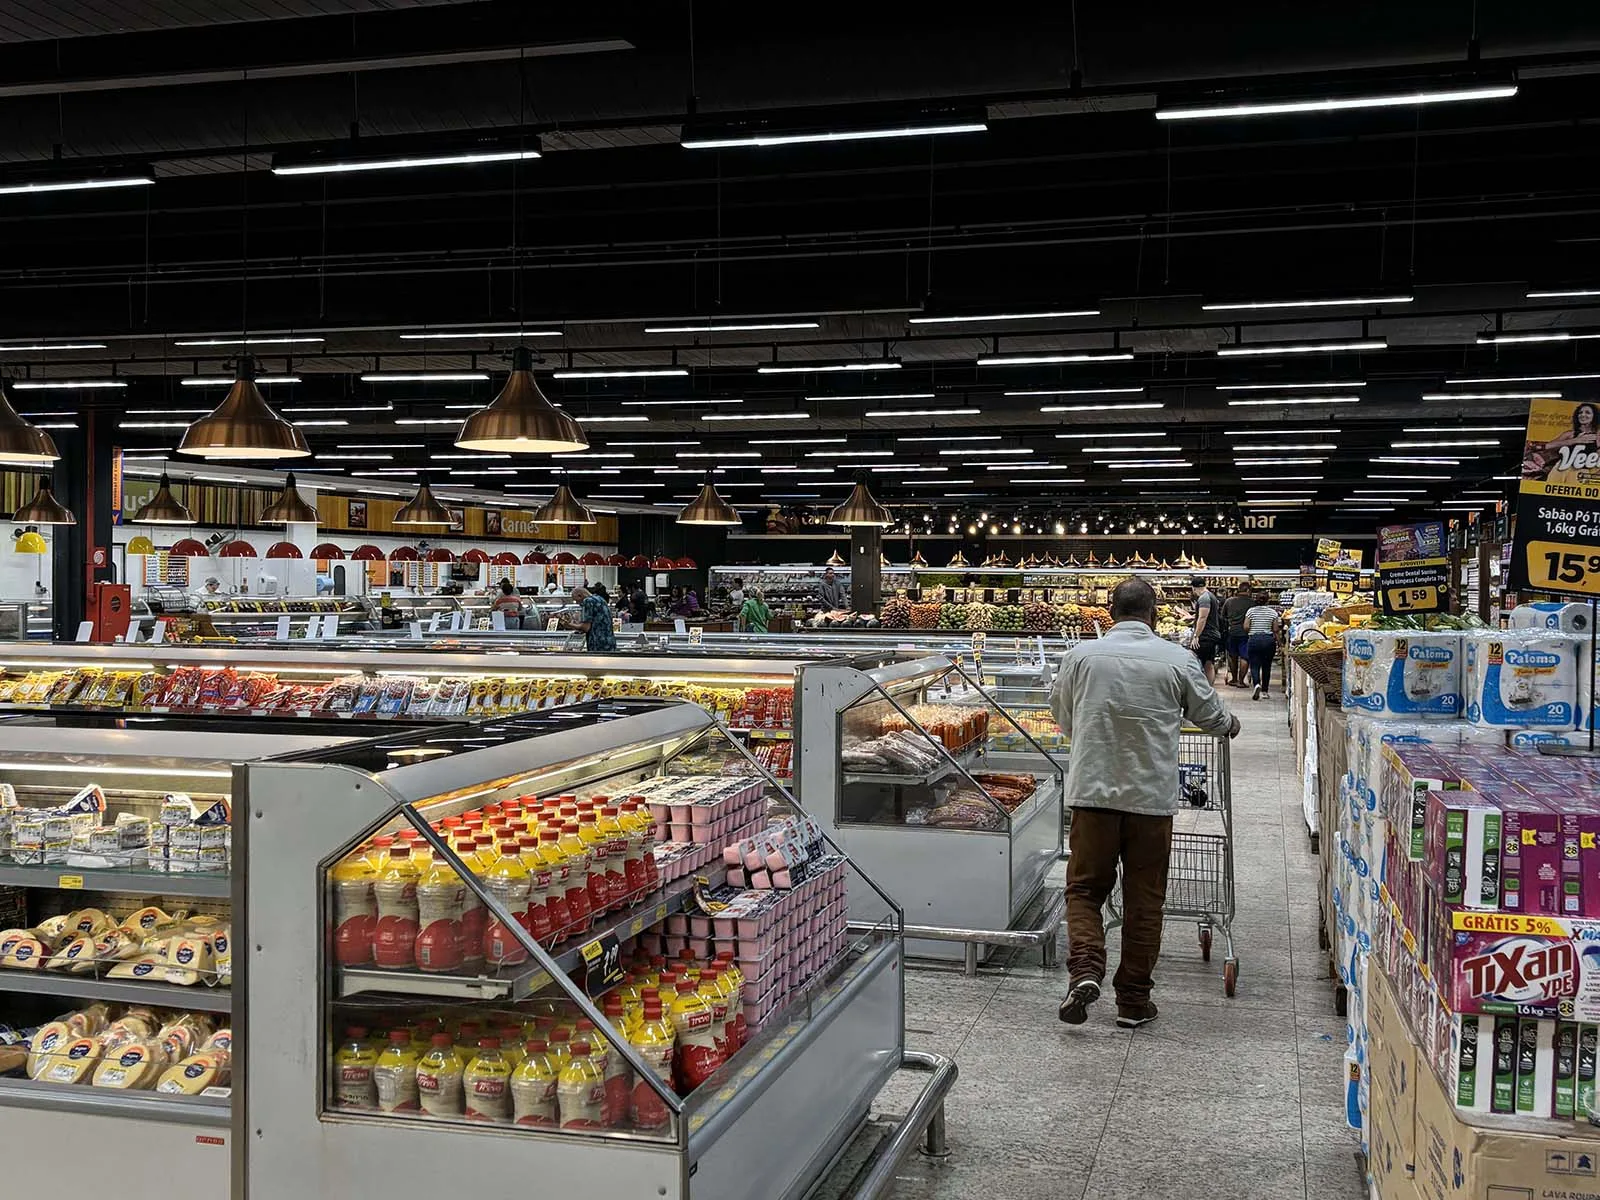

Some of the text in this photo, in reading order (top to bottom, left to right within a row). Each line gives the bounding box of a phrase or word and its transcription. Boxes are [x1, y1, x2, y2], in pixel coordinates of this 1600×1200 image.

[1559, 444, 1600, 470] Vee
[1545, 485, 1599, 497] OFERTA DO
[1538, 507, 1573, 520] Sabão
[1575, 510, 1591, 523] Pó
[501, 517, 540, 533] Carnes
[1545, 521, 1576, 537] 1,6kg
[1397, 639, 1406, 650] 12
[1489, 642, 1501, 655] 12
[1413, 647, 1451, 660] Paloma
[1508, 651, 1556, 664] Paloma
[1441, 695, 1455, 705] 20
[1548, 704, 1564, 715] 20
[1506, 843, 1518, 852] 28
[1565, 846, 1578, 855] 28
[1463, 915, 1519, 931] GRÁTIS
[1560, 1001, 1575, 1013] 28
[691, 1014, 710, 1026] Trevo
